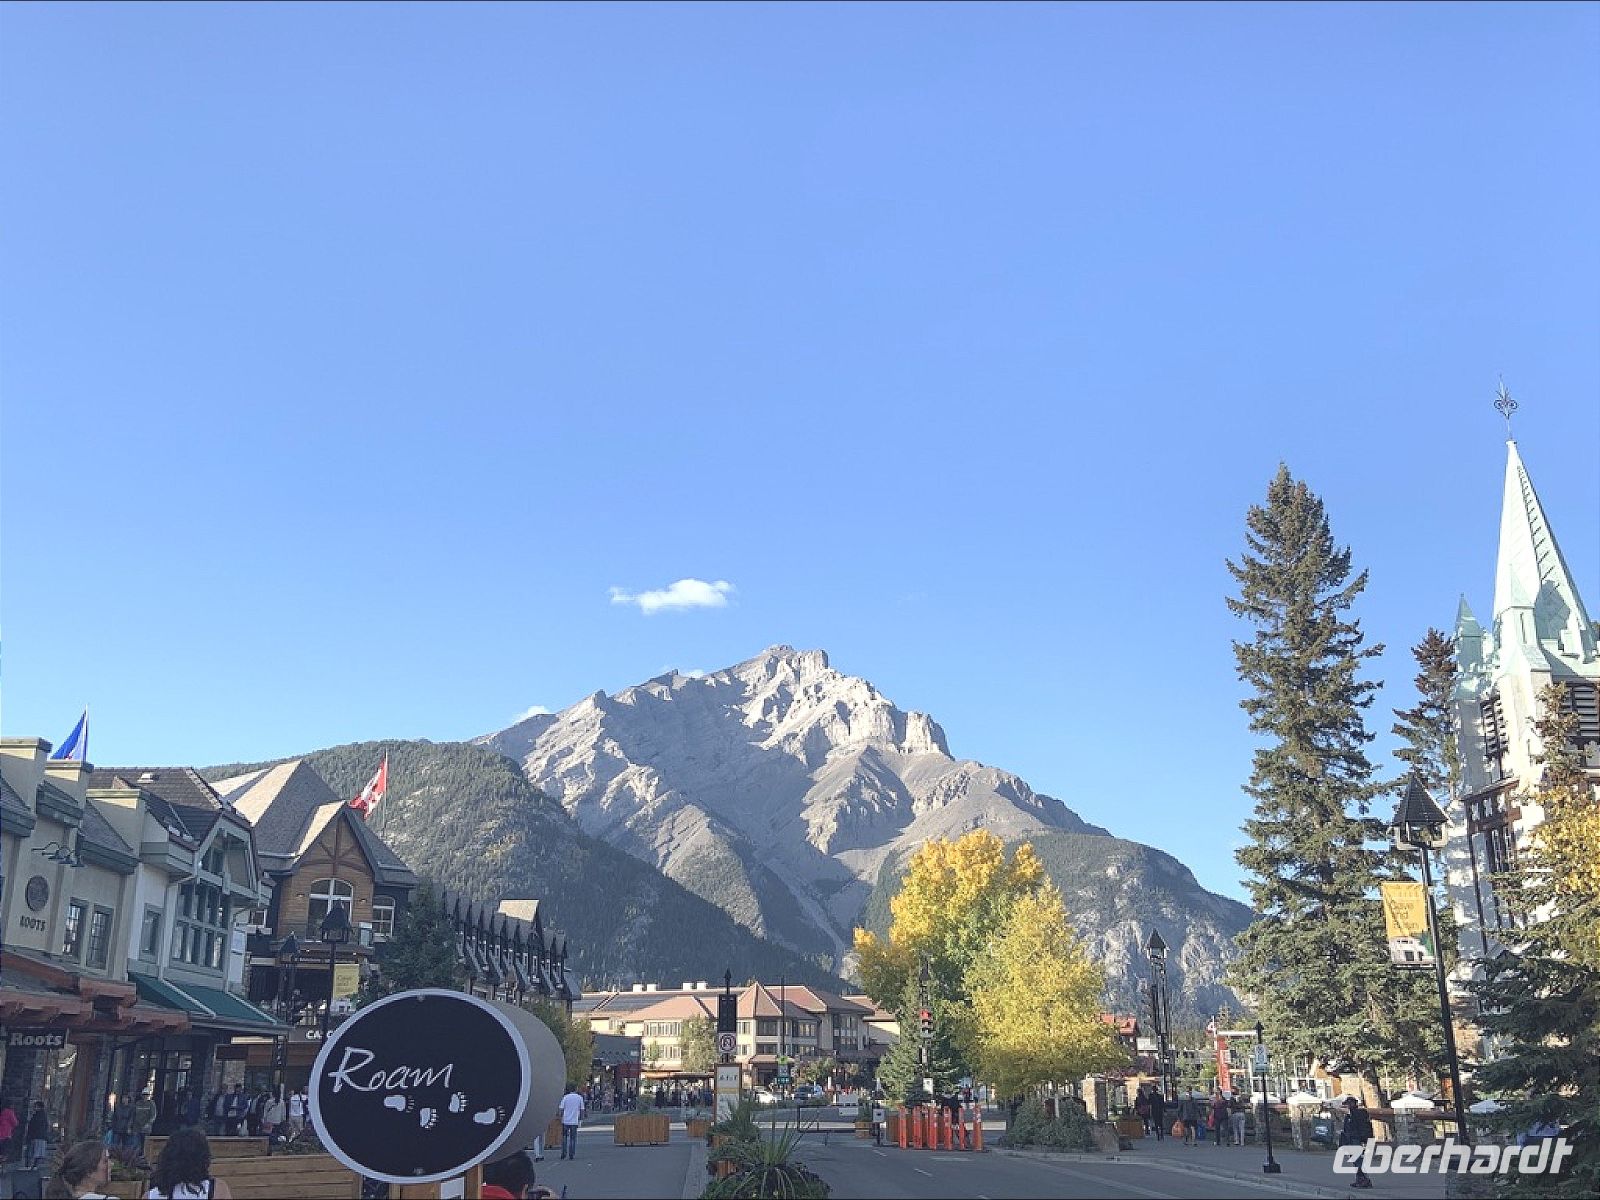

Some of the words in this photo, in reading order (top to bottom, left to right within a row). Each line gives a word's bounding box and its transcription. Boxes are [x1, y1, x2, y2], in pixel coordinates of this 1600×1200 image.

[19, 915, 47, 932] ROOTS
[9, 1032, 63, 1046] Roots
[328, 1046, 453, 1093] Roam
